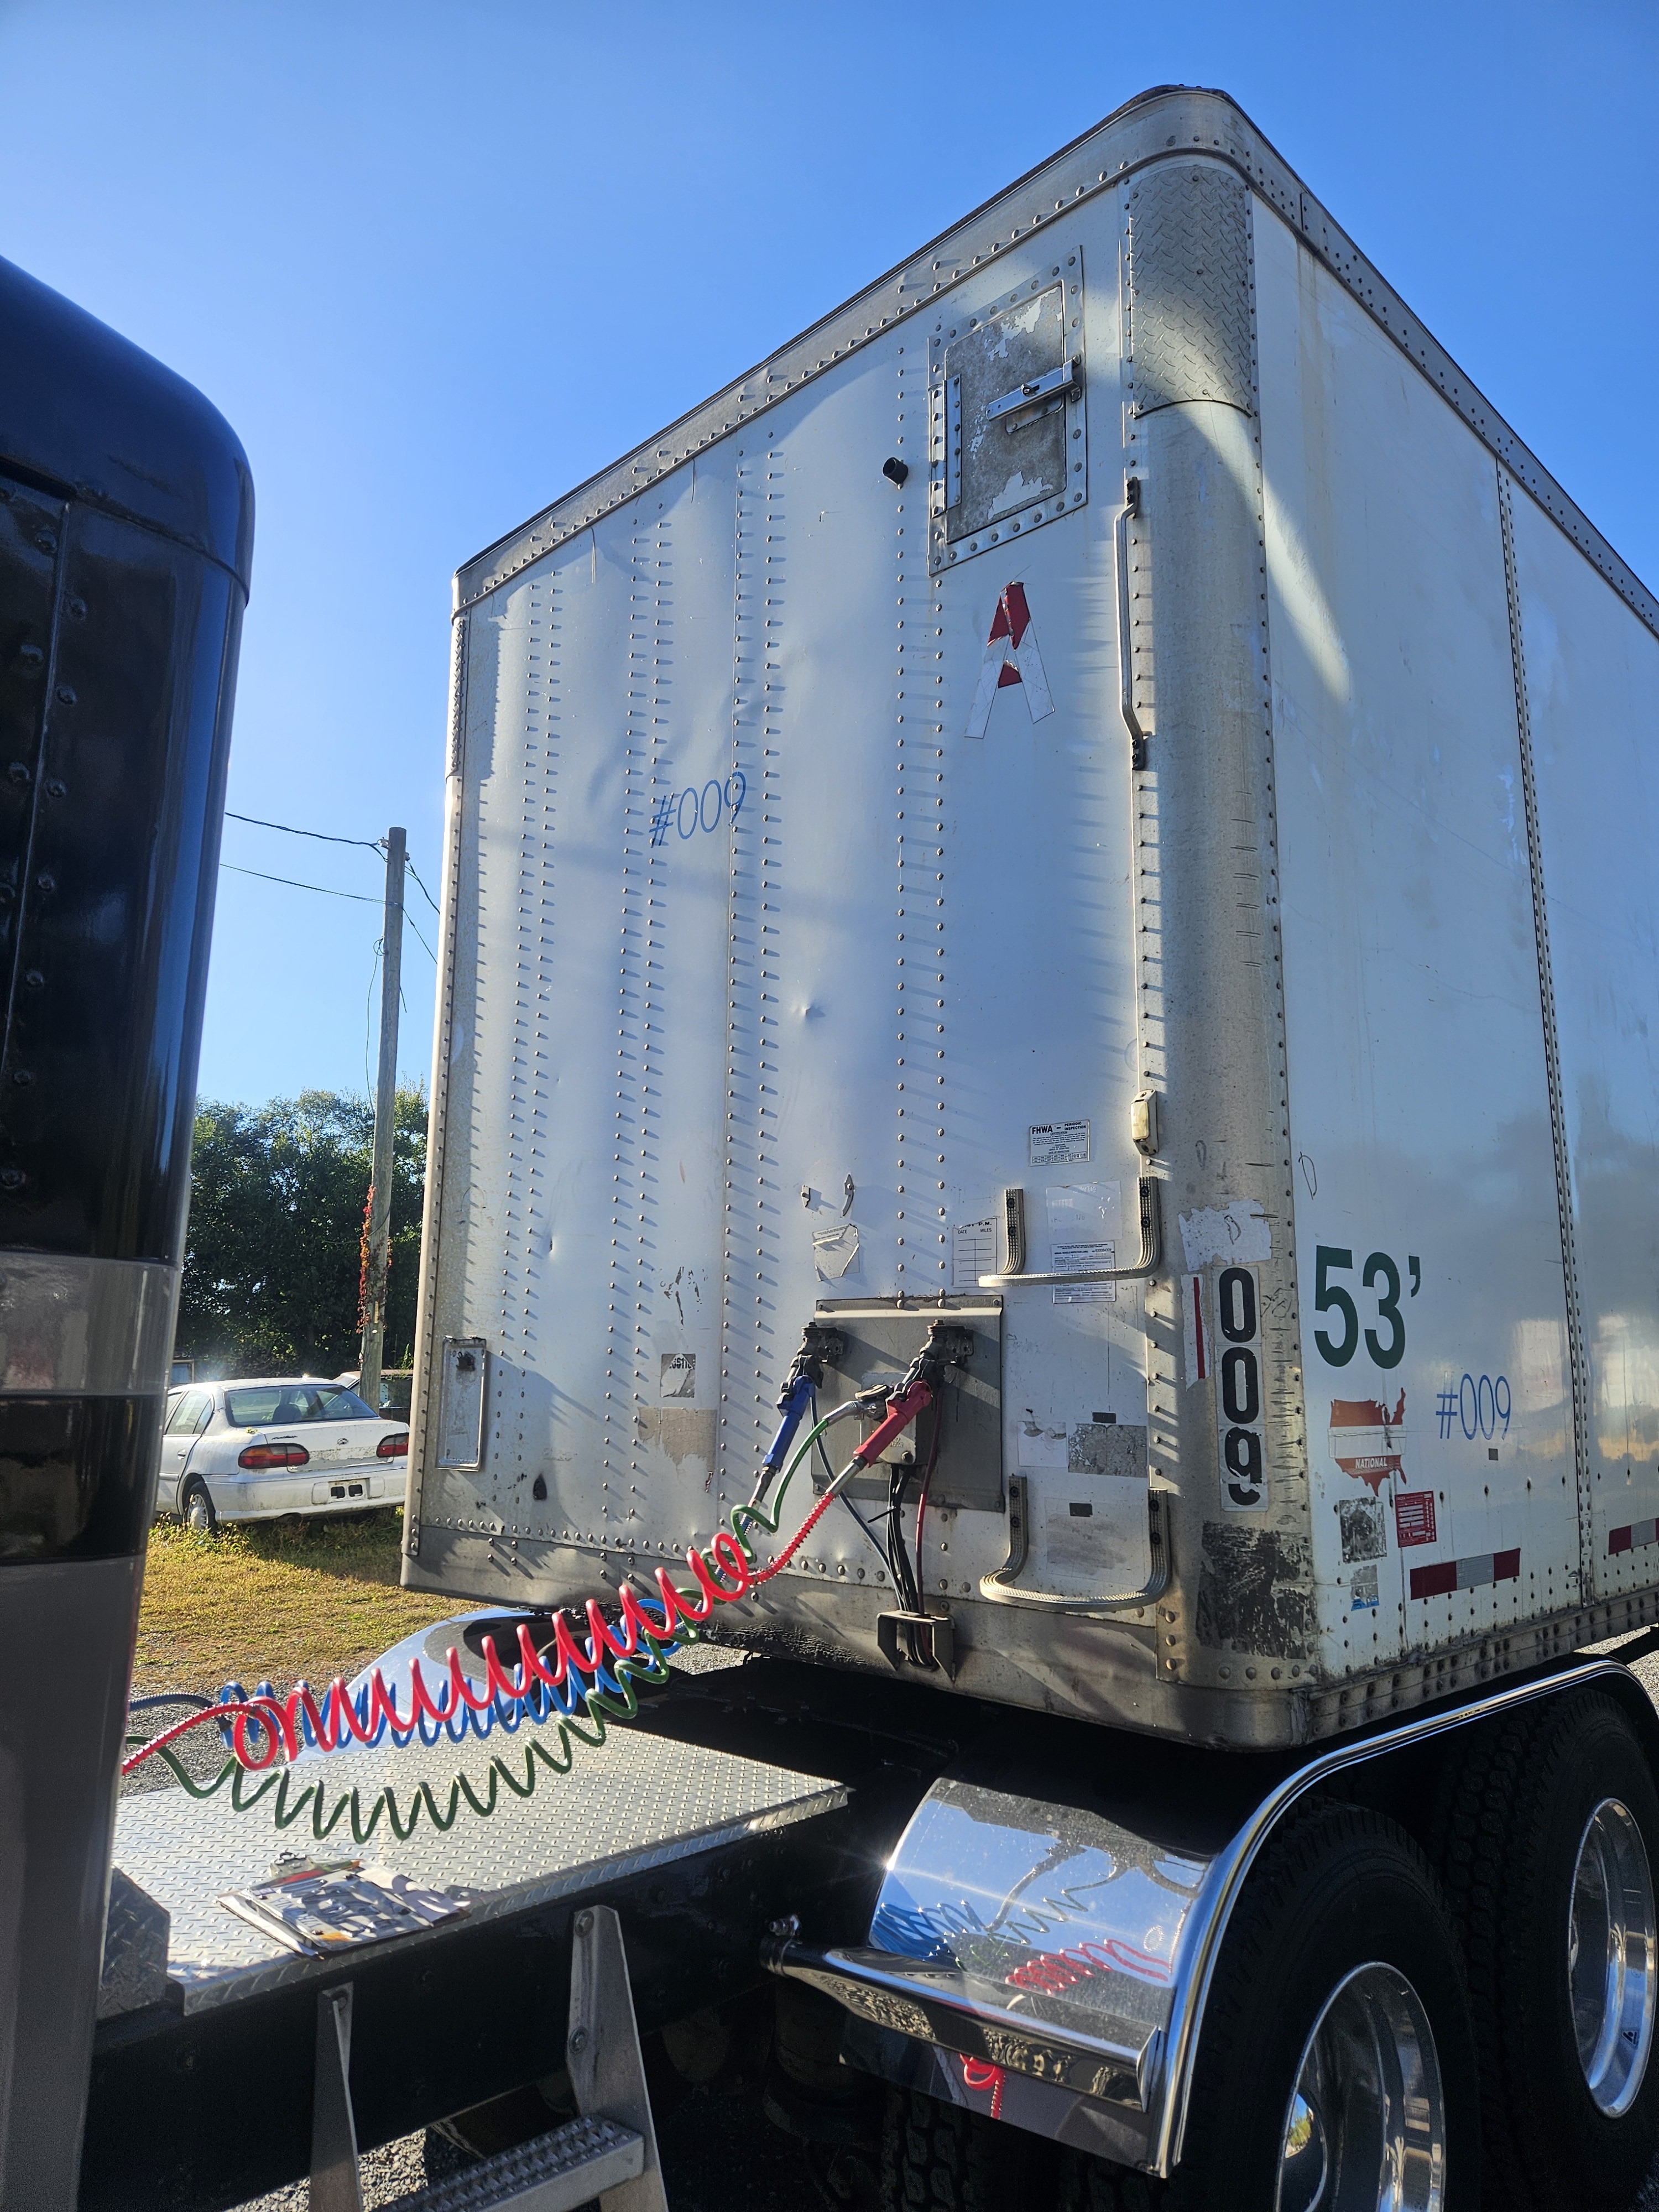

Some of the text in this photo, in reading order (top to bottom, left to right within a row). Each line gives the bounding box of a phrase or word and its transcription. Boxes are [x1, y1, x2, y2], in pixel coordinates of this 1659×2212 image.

[649, 771, 746, 848] #009
[1032, 1125, 1053, 1134] FHWA
[1314, 1245, 1421, 1369] 53'
[1436, 1371, 1511, 1440] #009
[1355, 1457, 1387, 1469] NATIONAL
